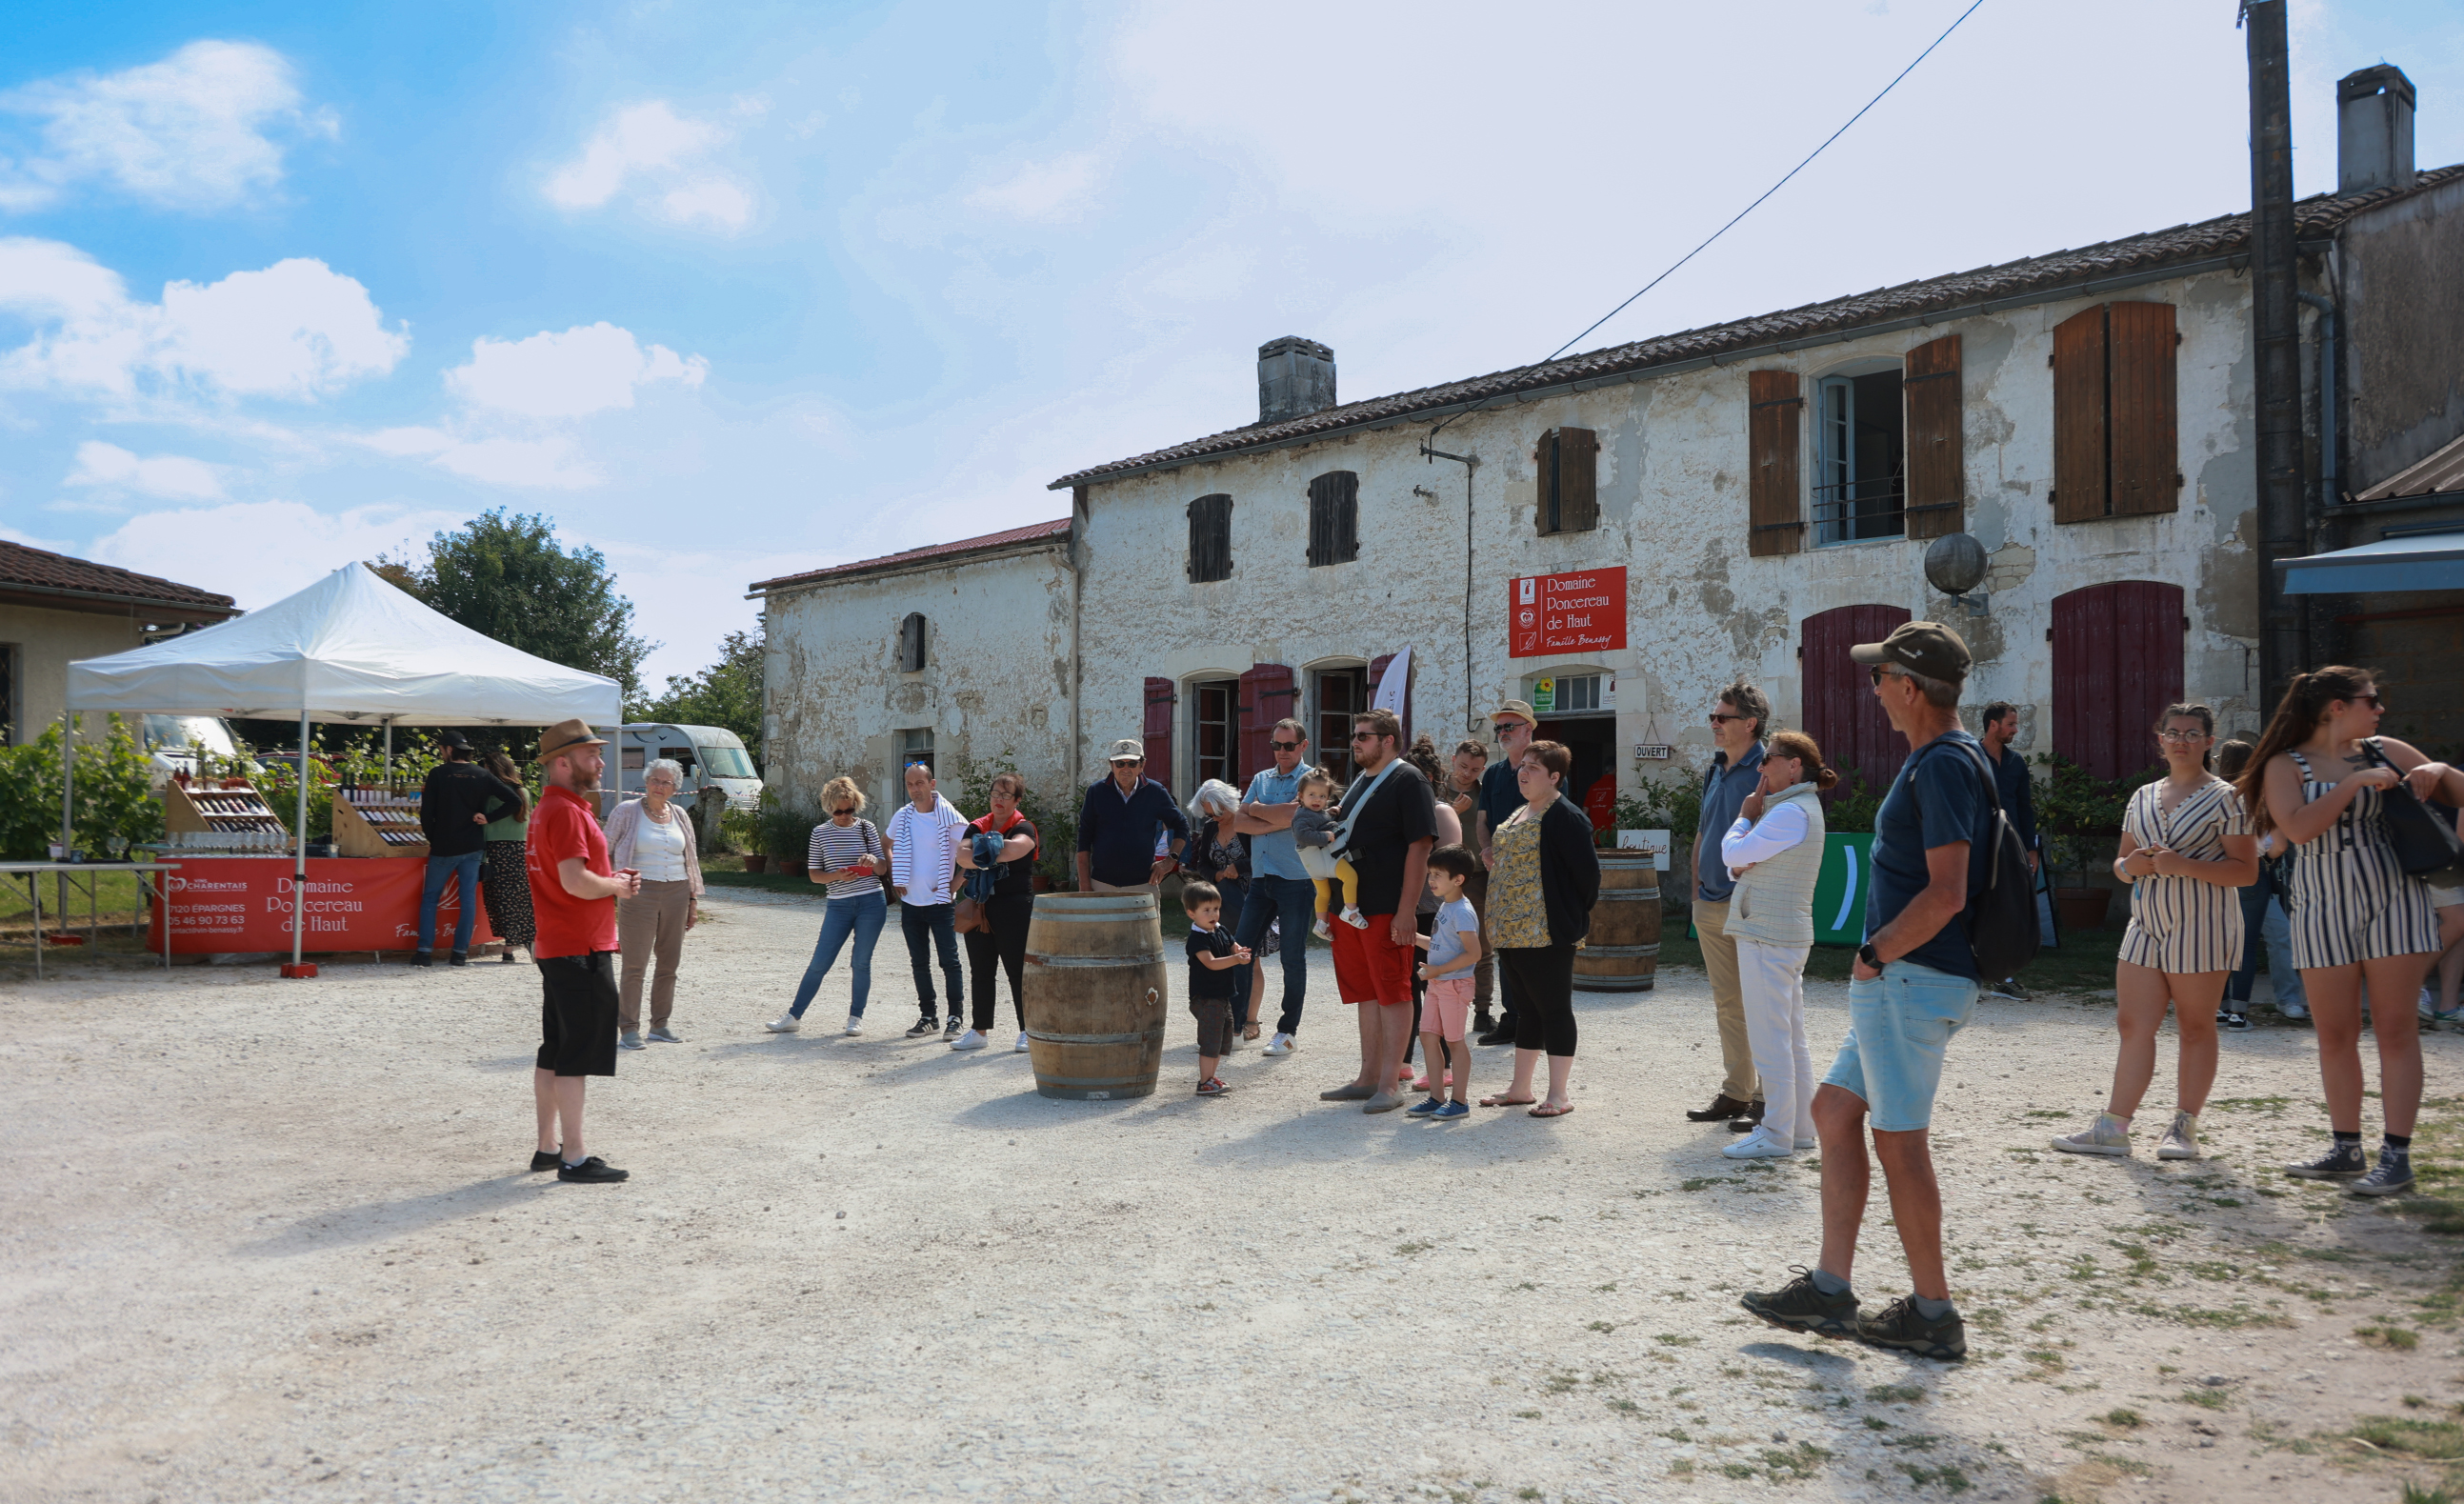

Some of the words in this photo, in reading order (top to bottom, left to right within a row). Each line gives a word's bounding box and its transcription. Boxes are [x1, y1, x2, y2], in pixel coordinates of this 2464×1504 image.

[1547, 575, 1596, 592] Domaine
[1547, 595, 1610, 611] Poncereau
[1546, 614, 1563, 631] de
[1567, 613, 1593, 629] Haut
[1546, 635, 1576, 648] Famille
[1577, 633, 1613, 650] Benassy
[1636, 746, 1667, 757] OUVERT
[169, 905, 190, 913] 7120
[191, 903, 246, 913] ÉPARGNES
[267, 896, 363, 912] Pocereau
[168, 916, 181, 926] 05
[183, 916, 196, 925] 46
[198, 915, 213, 925] 90
[215, 915, 229, 925] 73
[230, 915, 245, 924] 63
[311, 915, 350, 932] Haut
